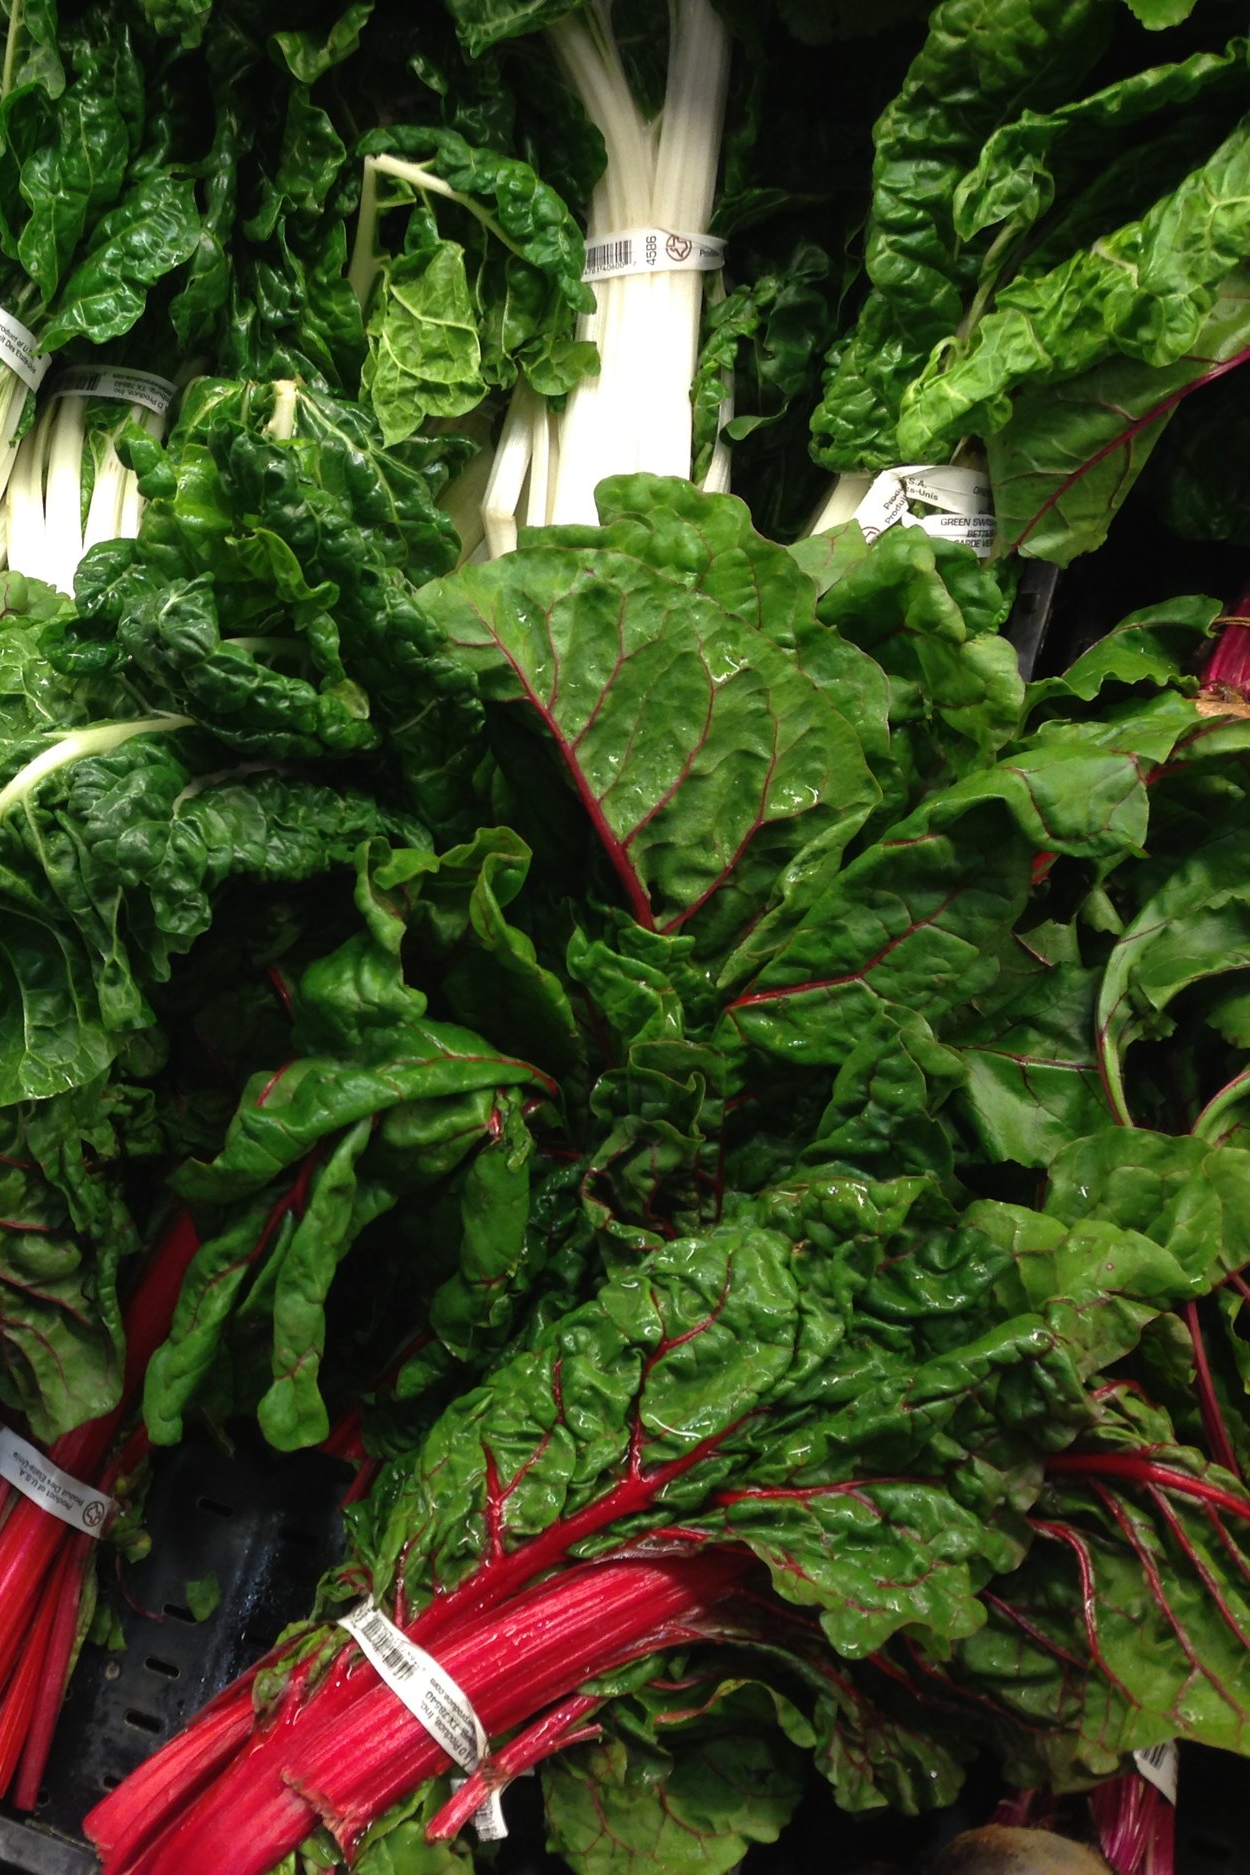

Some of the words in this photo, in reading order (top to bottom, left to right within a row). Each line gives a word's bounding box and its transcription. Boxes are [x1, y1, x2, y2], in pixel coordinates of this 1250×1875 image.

[646, 235, 657, 266] 4586
[5, 341, 16, 353] Des
[16, 340, 25, 349] of
[940, 517, 970, 527] GREEN
[47, 1479, 62, 1494] Des
[46, 1490, 73, 1511] Product
[61, 1489, 85, 1507] Produit
[420, 1700, 435, 1720] Inc.
[435, 1716, 462, 1752] Produce,
